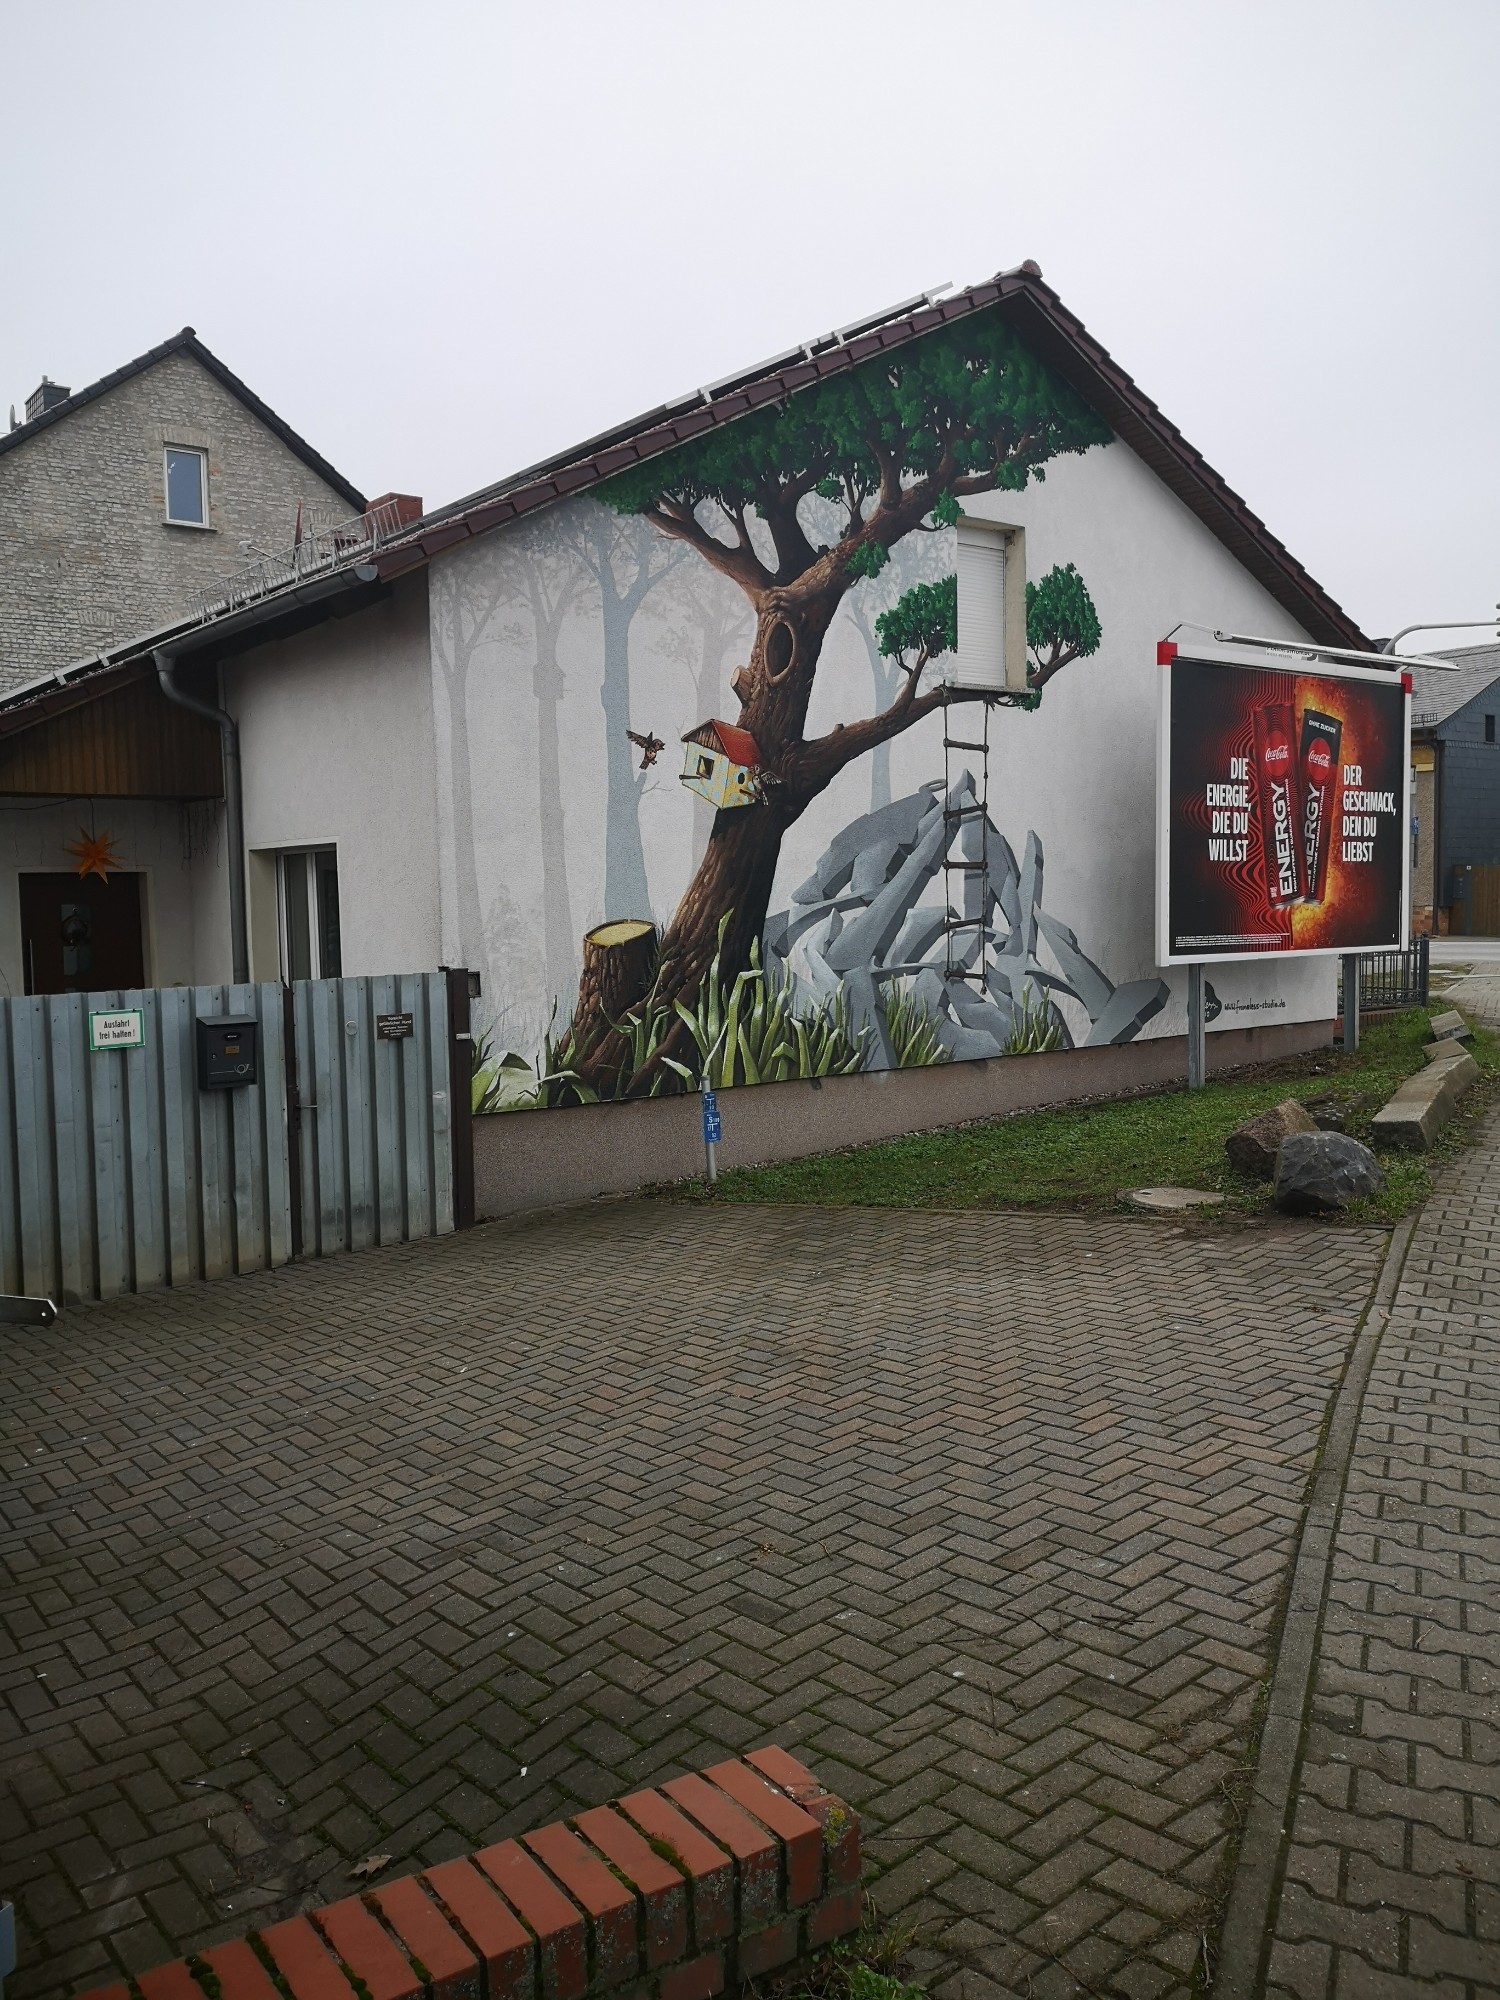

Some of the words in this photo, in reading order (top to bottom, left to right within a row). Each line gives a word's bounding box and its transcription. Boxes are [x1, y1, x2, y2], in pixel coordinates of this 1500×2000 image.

[1230, 757, 1249, 780] DIE
[1343, 764, 1362, 786] DER
[1206, 783, 1252, 812] ENERGIE,
[1342, 790, 1397, 816] GESCHMACK,
[1212, 811, 1231, 834] DIE
[1233, 812, 1249, 835] DU
[1342, 815, 1362, 837] DEN
[1363, 816, 1377, 838] DU
[1208, 838, 1249, 862] WILLST
[1271, 781, 1293, 896] ENERGY
[1342, 841, 1374, 862] LIEBST
[99, 1031, 110, 1040] frei
[103, 1019, 130, 1029] Ausfahrt
